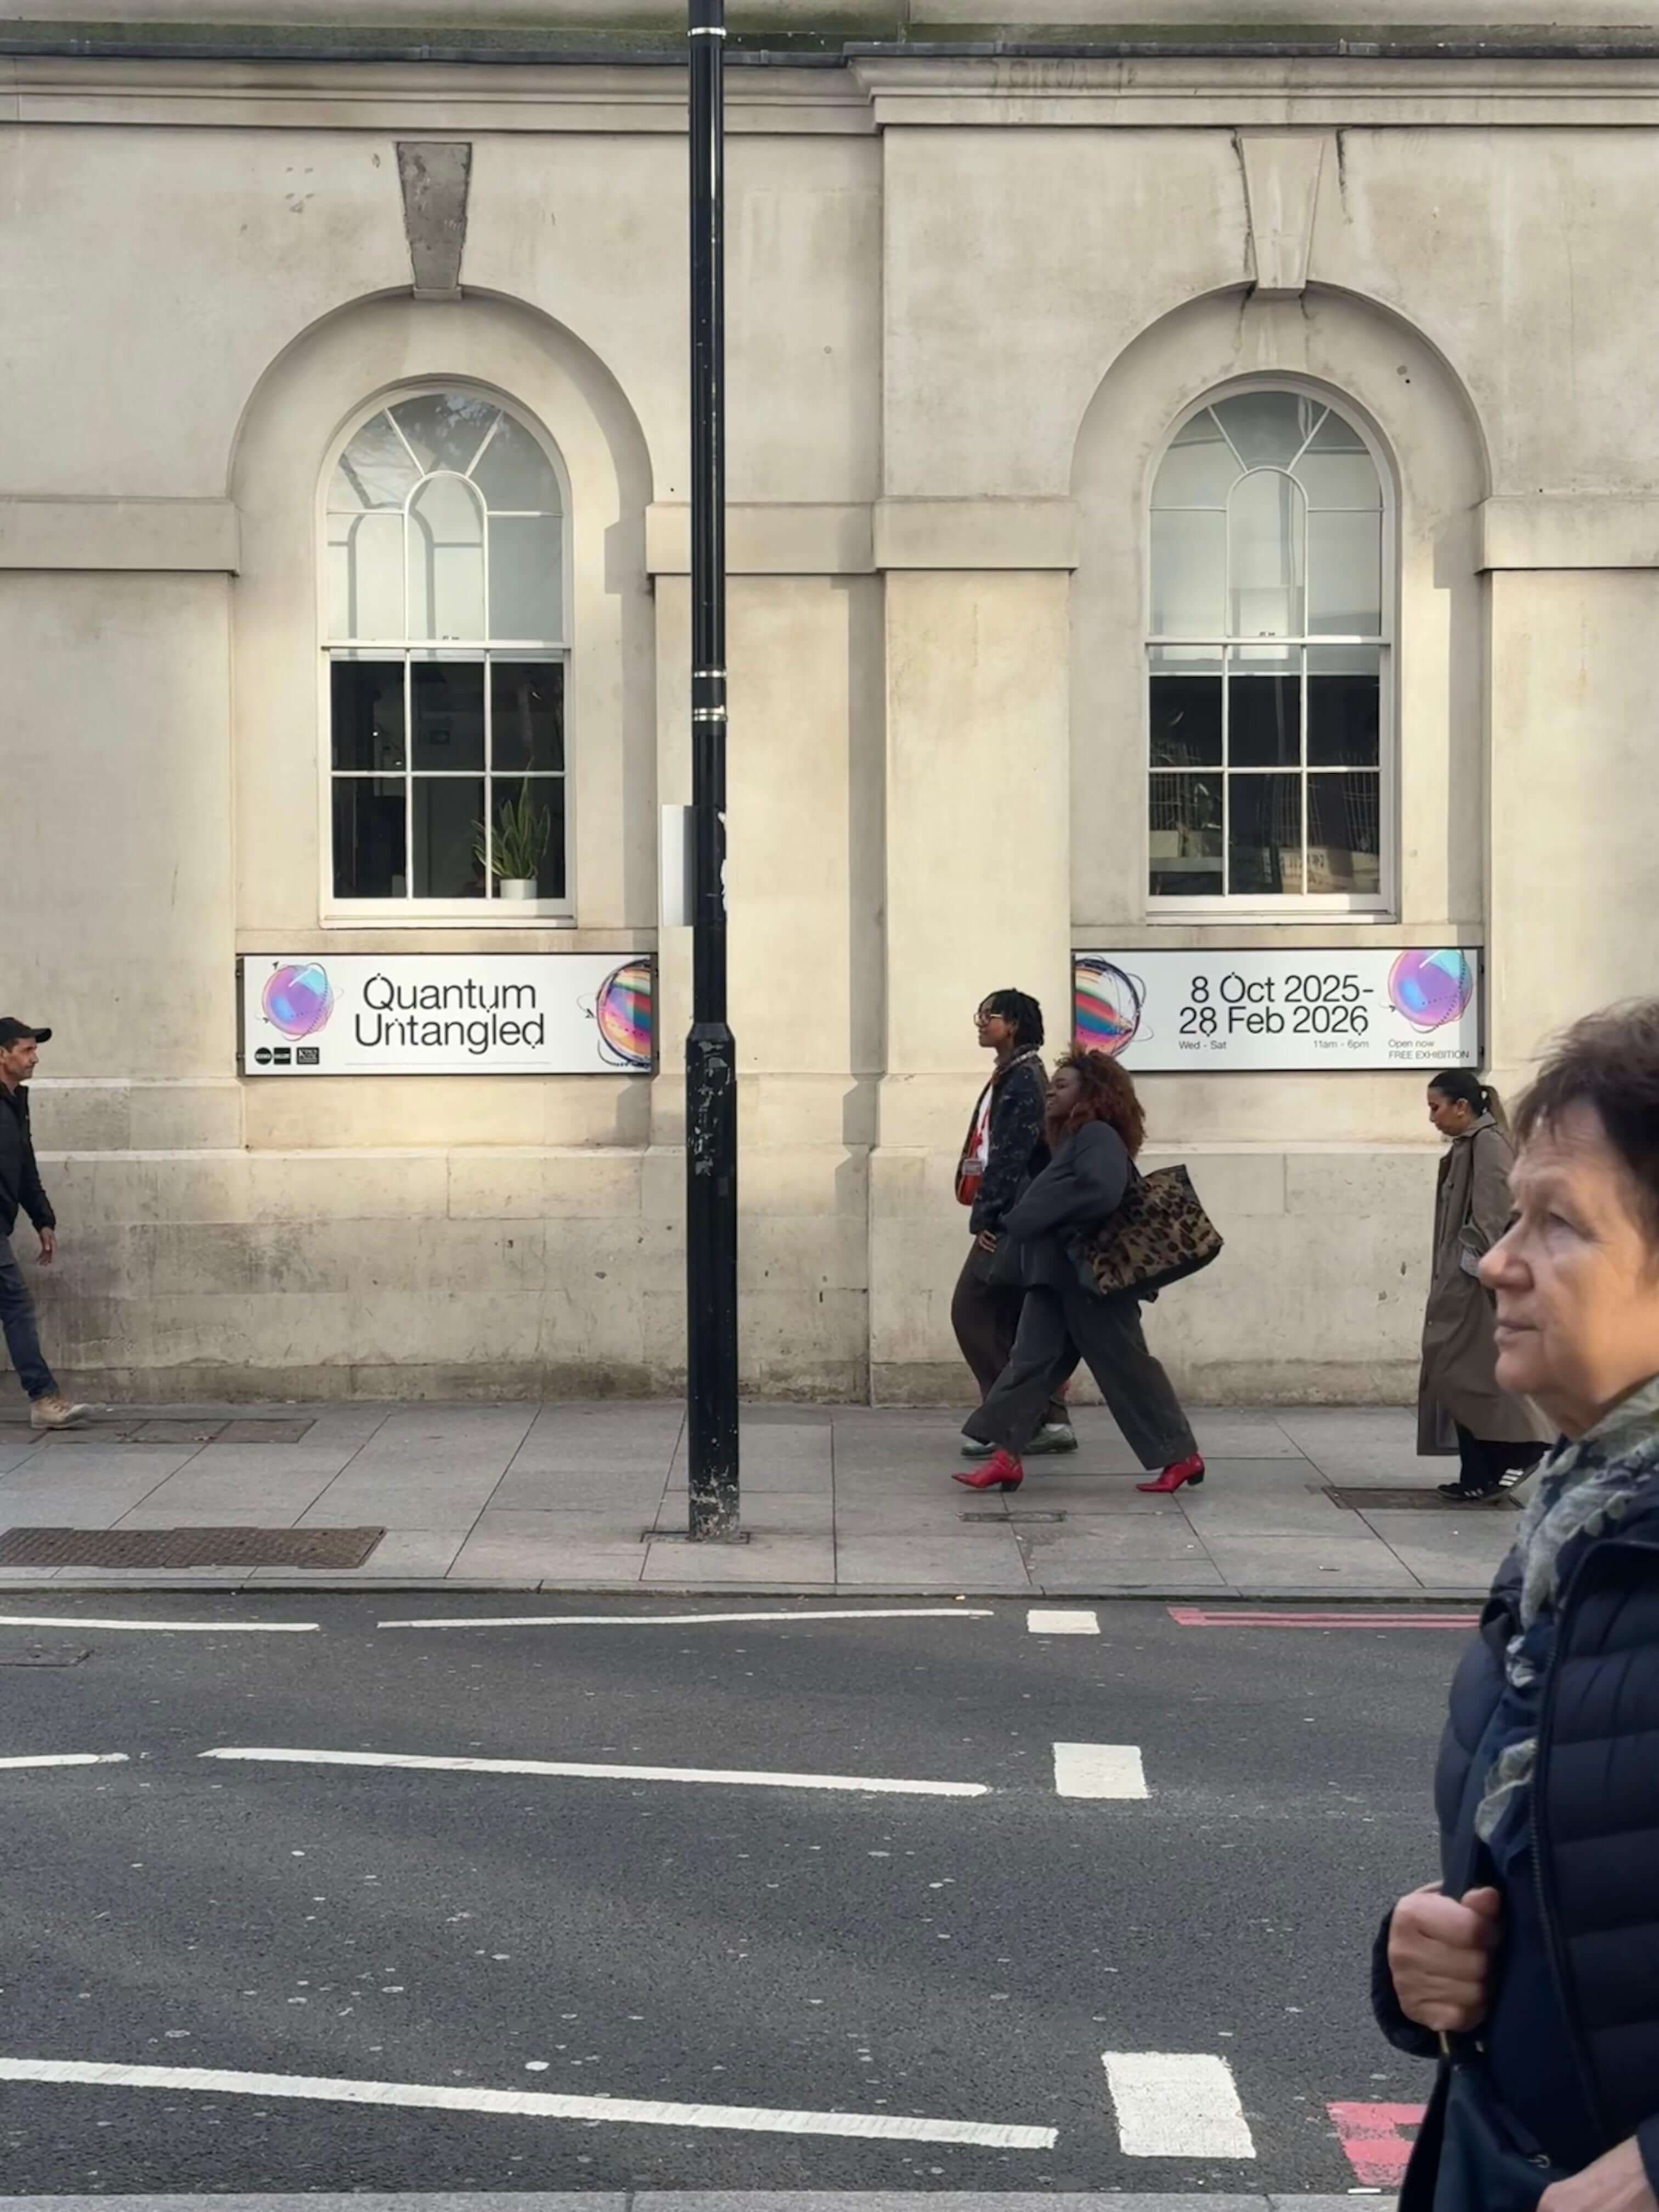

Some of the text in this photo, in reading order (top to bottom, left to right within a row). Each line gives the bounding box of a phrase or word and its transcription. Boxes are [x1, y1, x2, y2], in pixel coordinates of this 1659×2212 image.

[363, 973, 536, 1013] Quantum
[1190, 972, 1374, 1003] 8 Oct 2025-
[1179, 1005, 1369, 1037] 28 Feb 2026
[355, 1013, 545, 1055] Untangled
[1178, 1040, 1200, 1049] Wed
[1210, 1040, 1227, 1049] Sat
[1313, 1040, 1338, 1048] 11am
[1347, 1039, 1370, 1050] 6pm
[1388, 1039, 1413, 1048] Open
[1389, 1049, 1470, 1059] FREE EXHIBITION
